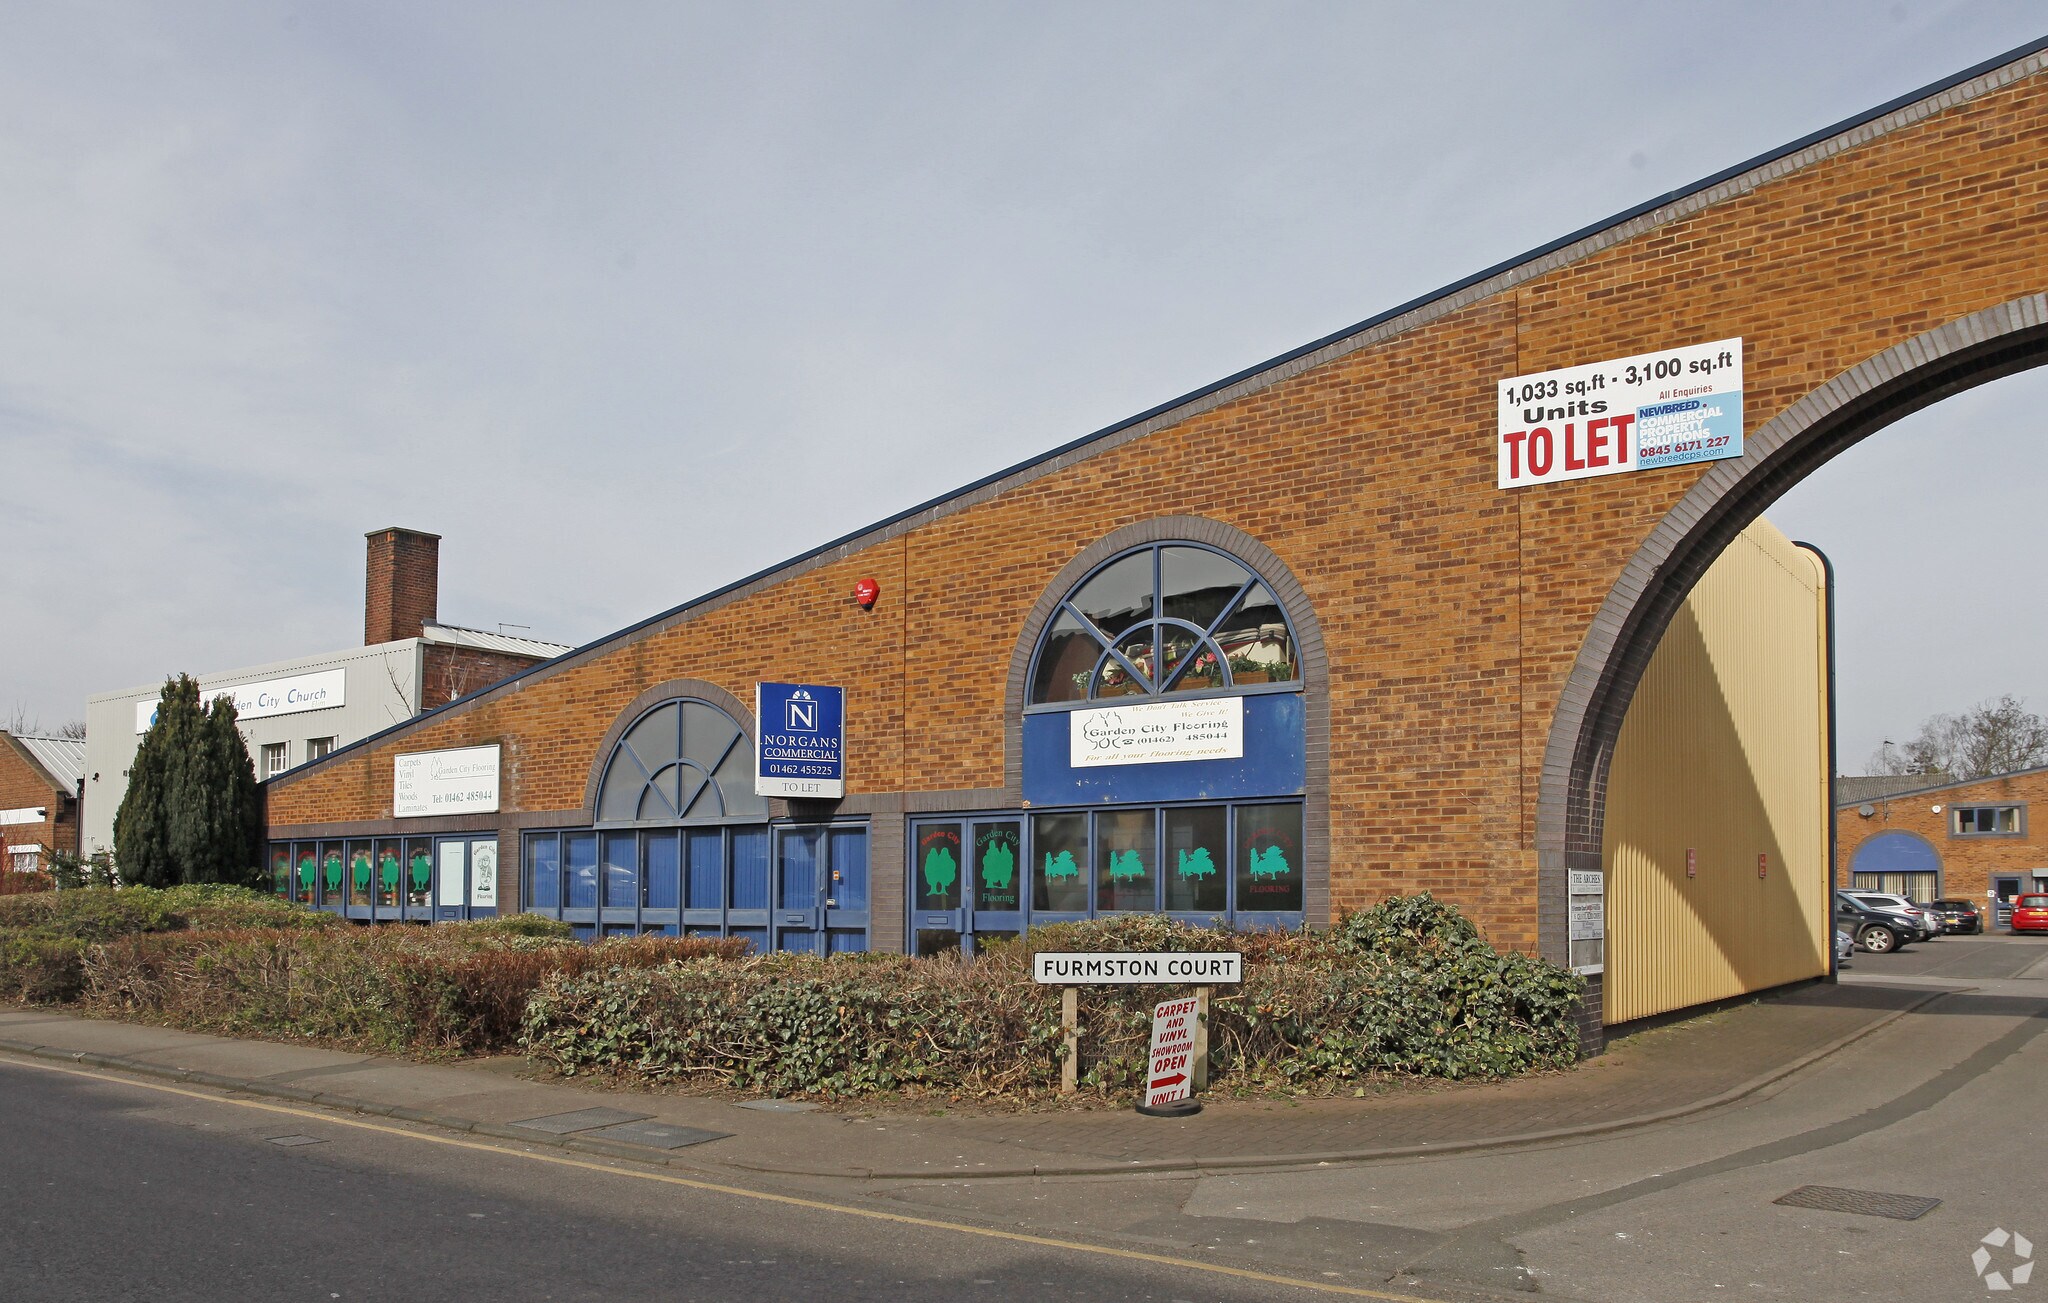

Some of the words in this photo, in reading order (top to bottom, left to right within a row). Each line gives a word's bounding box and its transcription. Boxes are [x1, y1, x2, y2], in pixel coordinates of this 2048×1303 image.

[1507, 379, 1558, 407] 1,033
[1565, 374, 1605, 396] sq.ft
[1625, 357, 1681, 387] 3,100
[1689, 351, 1733, 376] sq.ft
[1659, 390, 1670, 400] All
[1673, 385, 1713, 399] Enquiries
[1524, 400, 1608, 424] Units
[1639, 400, 1700, 418] NEWBREED
[1639, 406, 1723, 429] COMMERCIAL
[1639, 418, 1705, 439] PROPERTY
[1639, 427, 1710, 449] SOLUTIONS
[1503, 426, 1553, 480] TO
[1565, 413, 1635, 472] LET
[1639, 445, 1671, 458] 0845
[1674, 440, 1702, 453] 6171
[1706, 436, 1730, 448] 227
[1640, 447, 1724, 465] newbreedcps.com
[258, 693, 281, 708] City
[287, 687, 327, 704] Church
[790, 703, 813, 728] N
[1089, 727, 1136, 738] Garden
[1141, 724, 1168, 735] City
[1173, 720, 1229, 732] Flooring
[764, 734, 838, 749] NORGANS
[1137, 735, 1175, 746] (01462)
[1185, 732, 1228, 741] 485044
[764, 747, 838, 760] COMMERCIAL
[1084, 754, 1102, 762] For
[1104, 752, 1119, 760] all
[1121, 752, 1146, 761] your
[1149, 749, 1194, 759] flooring
[1196, 746, 1227, 755] needs
[399, 758, 422, 769] Carpets
[438, 766, 458, 775] Garden
[459, 764, 470, 774] City
[472, 763, 496, 772] Flooring
[770, 764, 798, 774] 01462
[800, 765, 833, 775] 455225
[399, 769, 415, 779] Vinyl
[399, 780, 413, 790] Tiles
[782, 782, 798, 792] TO
[801, 783, 821, 792] LET
[399, 792, 418, 801] Woods
[432, 794, 443, 804] Tel:
[444, 792, 464, 803] 01462
[466, 790, 492, 801] 485044
[399, 804, 428, 813] Laminates
[976, 830, 1003, 847] Garden
[1005, 830, 1020, 846] City
[1572, 874, 1582, 884] THE
[1249, 885, 1290, 893] FLOORING
[982, 892, 1015, 904] Flooring
[1044, 959, 1158, 977] FURMSTON
[1167, 959, 1235, 977] COURT
[1156, 1000, 1197, 1019] CARPET
[1166, 1017, 1184, 1030] AND
[1159, 1028, 1188, 1043] VINYL
[1151, 1041, 1193, 1058] SHOWROOM
[1154, 1054, 1187, 1074] OPEN
[1151, 1089, 1177, 1105] UNIT
[1179, 1088, 1185, 1099] 1
